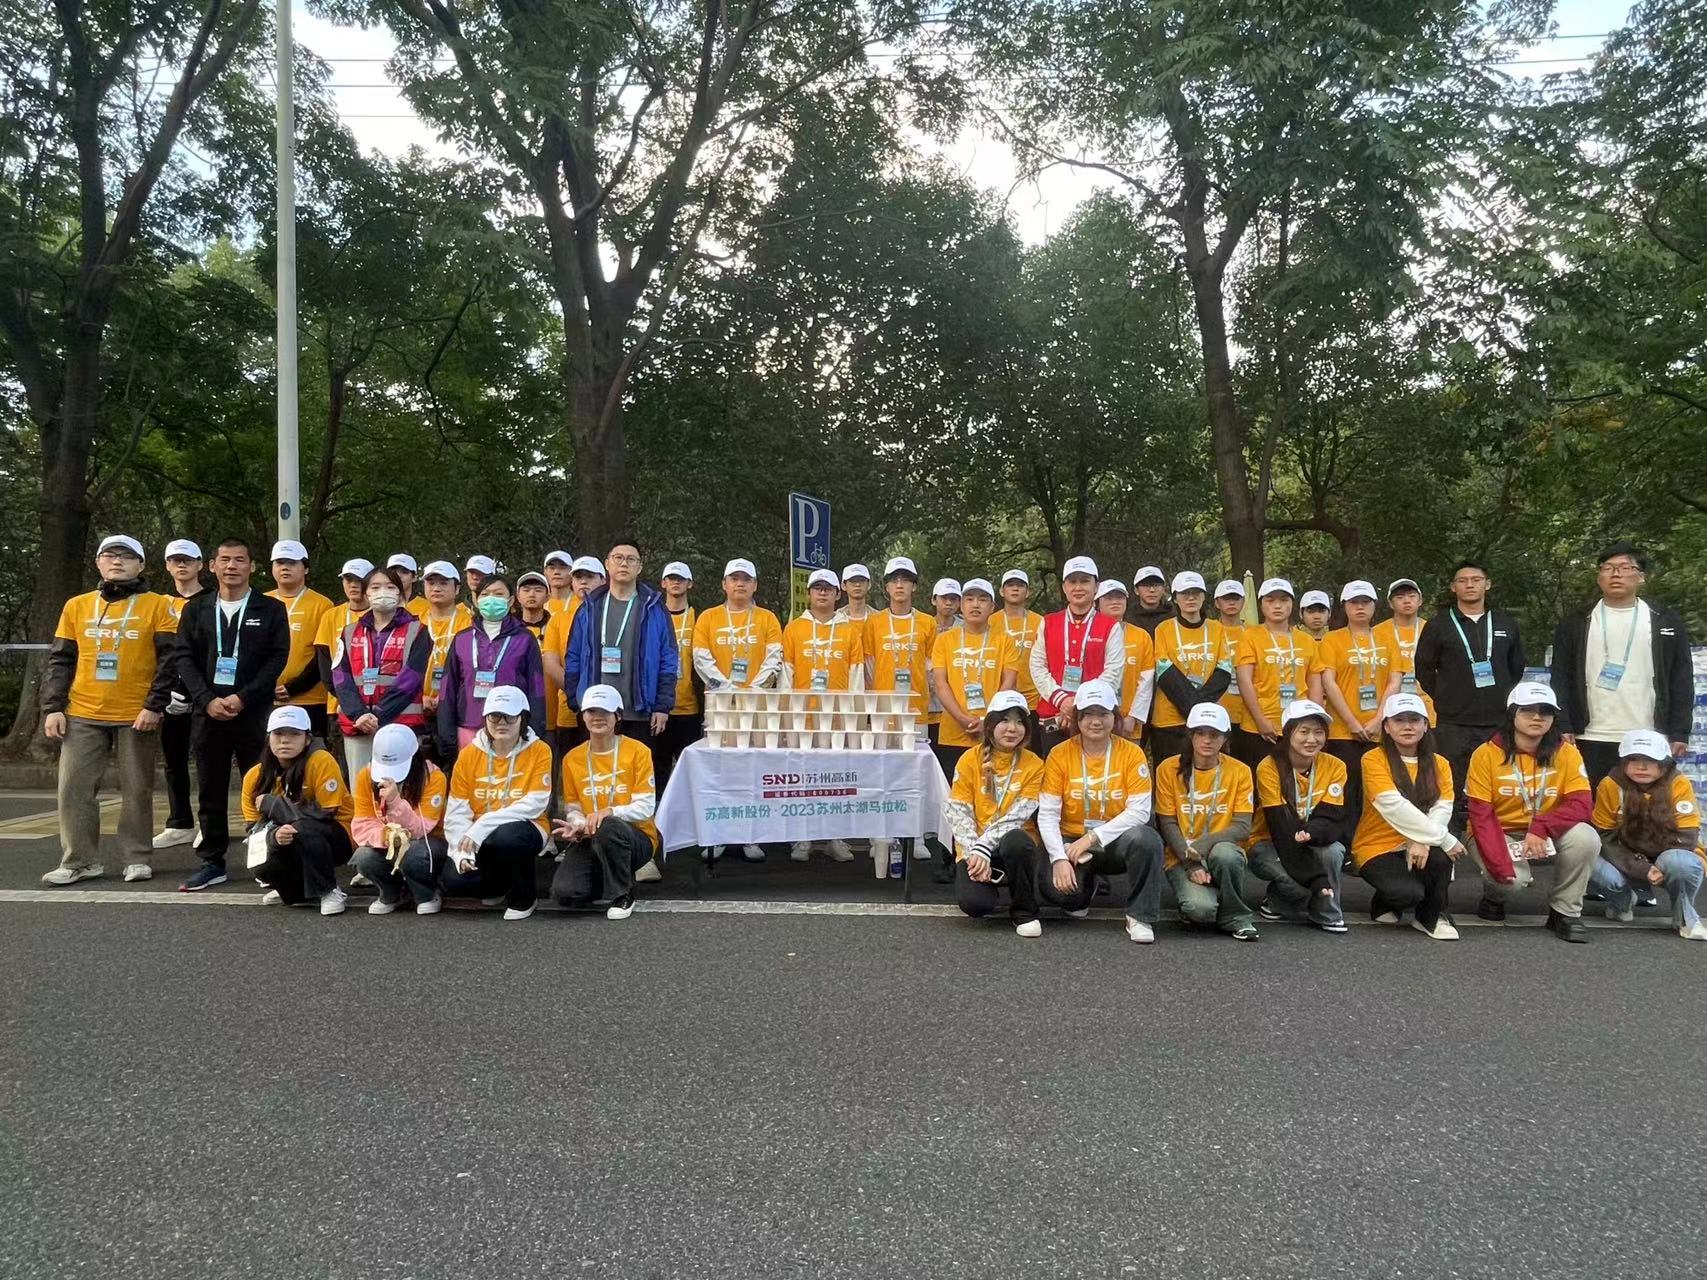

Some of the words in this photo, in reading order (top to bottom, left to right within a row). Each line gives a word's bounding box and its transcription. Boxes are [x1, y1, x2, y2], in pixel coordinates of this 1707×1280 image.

[795, 498, 819, 563] P
[716, 635, 758, 645] ERKE
[882, 642, 919, 651] ERKE
[803, 648, 844, 659] ERKE
[1264, 655, 1305, 666] ERKE
[1347, 656, 1390, 667] ERKE
[762, 774, 801, 785] SND
[805, 771, 858, 784] 苏州高新
[473, 788, 524, 800] ERKE
[583, 783, 628, 797] ERKE
[1070, 788, 1124, 800] ERKE
